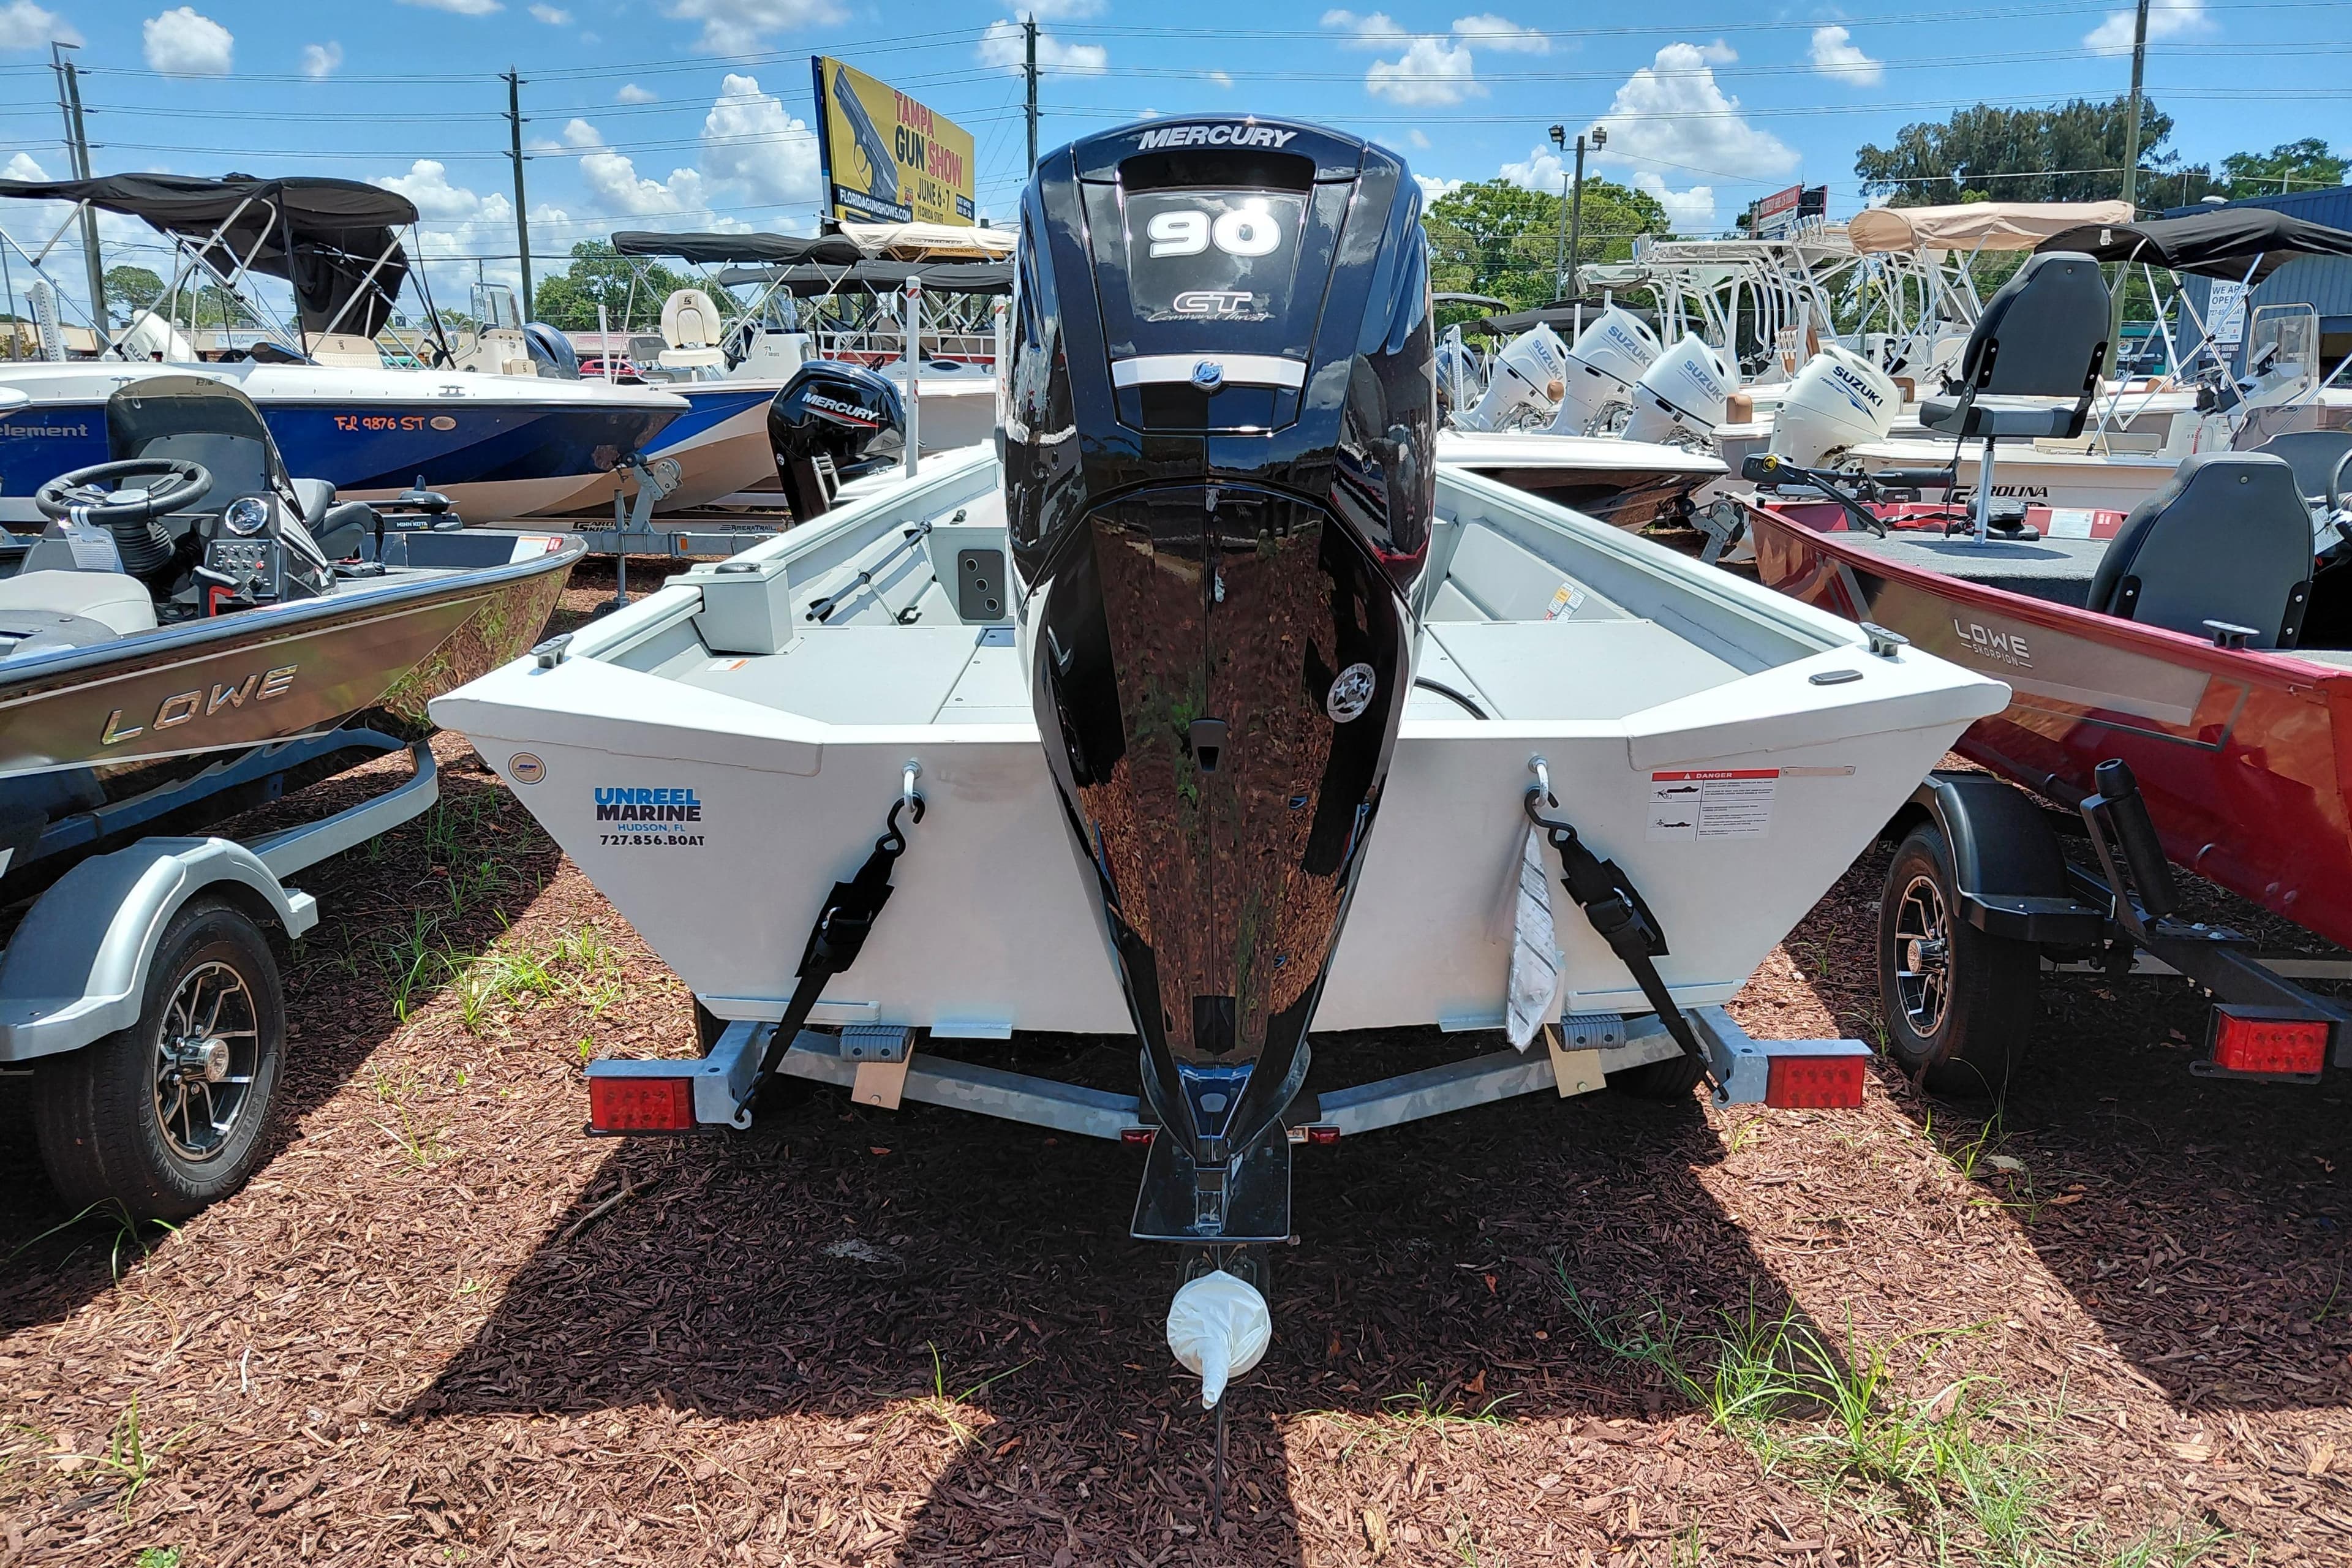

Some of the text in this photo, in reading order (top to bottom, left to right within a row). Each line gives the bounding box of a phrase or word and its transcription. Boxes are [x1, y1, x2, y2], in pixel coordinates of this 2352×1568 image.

[894, 90, 935, 139] TAMPA
[1137, 125, 1298, 150] MERCURY
[895, 124, 963, 189] GUN SHOW
[839, 188, 911, 222] FLORIDAGUNSHOWS.COM
[918, 177, 935, 206] JUNE
[918, 206, 933, 219] FLORIDA
[934, 211, 944, 224] STATE
[1147, 210, 1281, 258] 90
[2228, 285, 2246, 294] ARE
[1147, 309, 1276, 322] Command Thrust
[1532, 339, 1564, 381] SUZUKI
[1608, 325, 1653, 369] SUZUKI
[1684, 360, 1727, 405] SUZUKI
[1832, 365, 1884, 407] SUZUKI
[802, 393, 880, 421] MERCURY
[334, 416, 425, 431] FL 9876 ST
[1954, 619, 2030, 659] LOWE
[1972, 644, 2019, 667] SKORPION
[101, 663, 299, 745] LOWE
[594, 787, 701, 805] UNREEL
[596, 805, 701, 822] MARINE
[600, 834, 705, 846] 727.856.BOAT
[617, 823, 672, 833] HUDSON,
